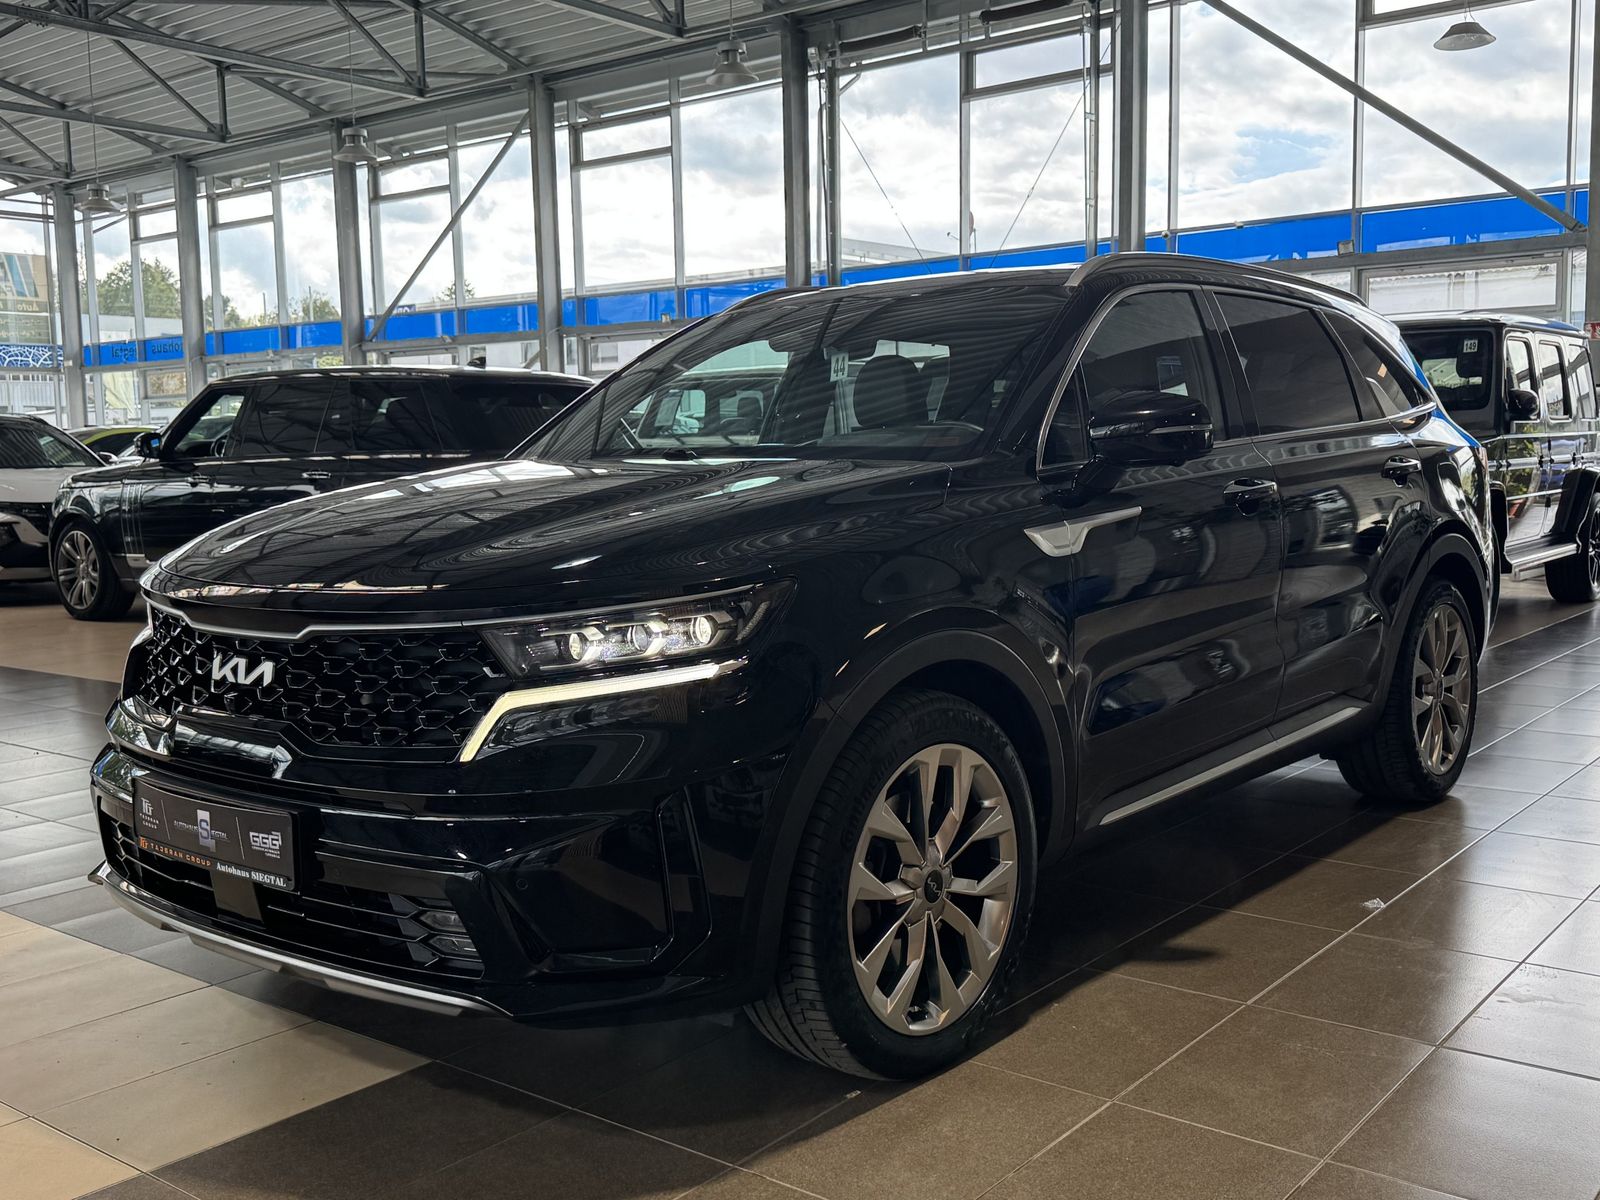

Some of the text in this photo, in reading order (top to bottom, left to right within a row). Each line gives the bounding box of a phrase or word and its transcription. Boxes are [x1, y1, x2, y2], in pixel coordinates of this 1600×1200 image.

[1465, 342, 1477, 352] 149
[833, 355, 846, 377] 44
[211, 653, 275, 687] KIA
[186, 854, 211, 866] GROUP
[216, 862, 287, 887] Autohaus SIEGTAL
